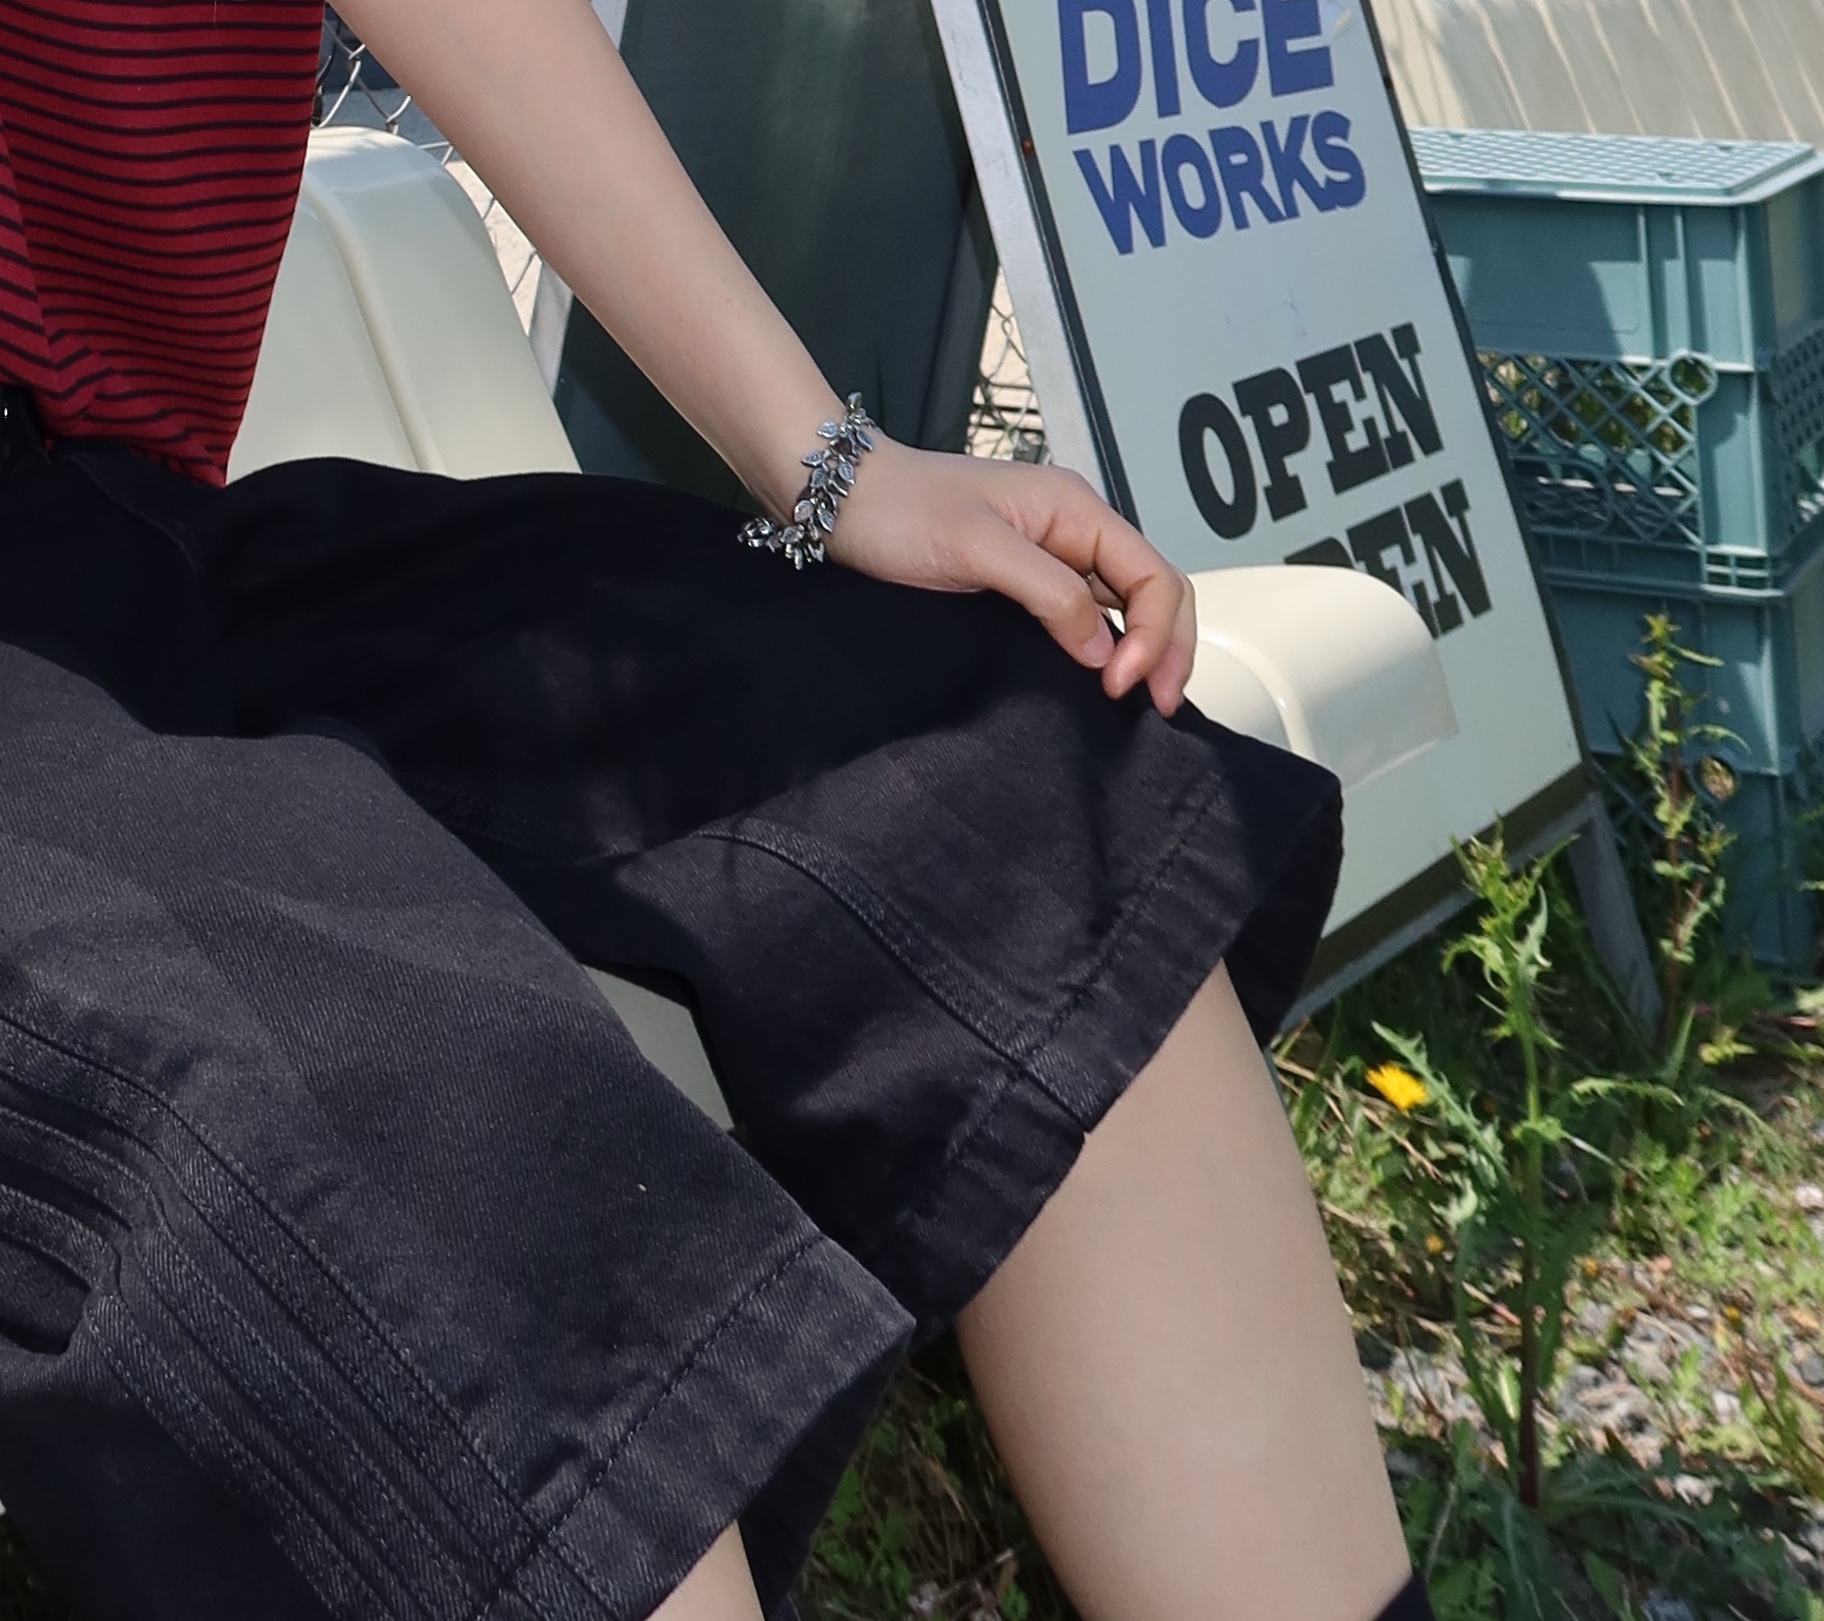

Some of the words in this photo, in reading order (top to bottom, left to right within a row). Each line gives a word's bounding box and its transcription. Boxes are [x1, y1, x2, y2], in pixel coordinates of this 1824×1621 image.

[1073, 110, 1368, 255] WORKS
[1178, 322, 1443, 541] OPEN
[1283, 478, 1493, 641] EN
